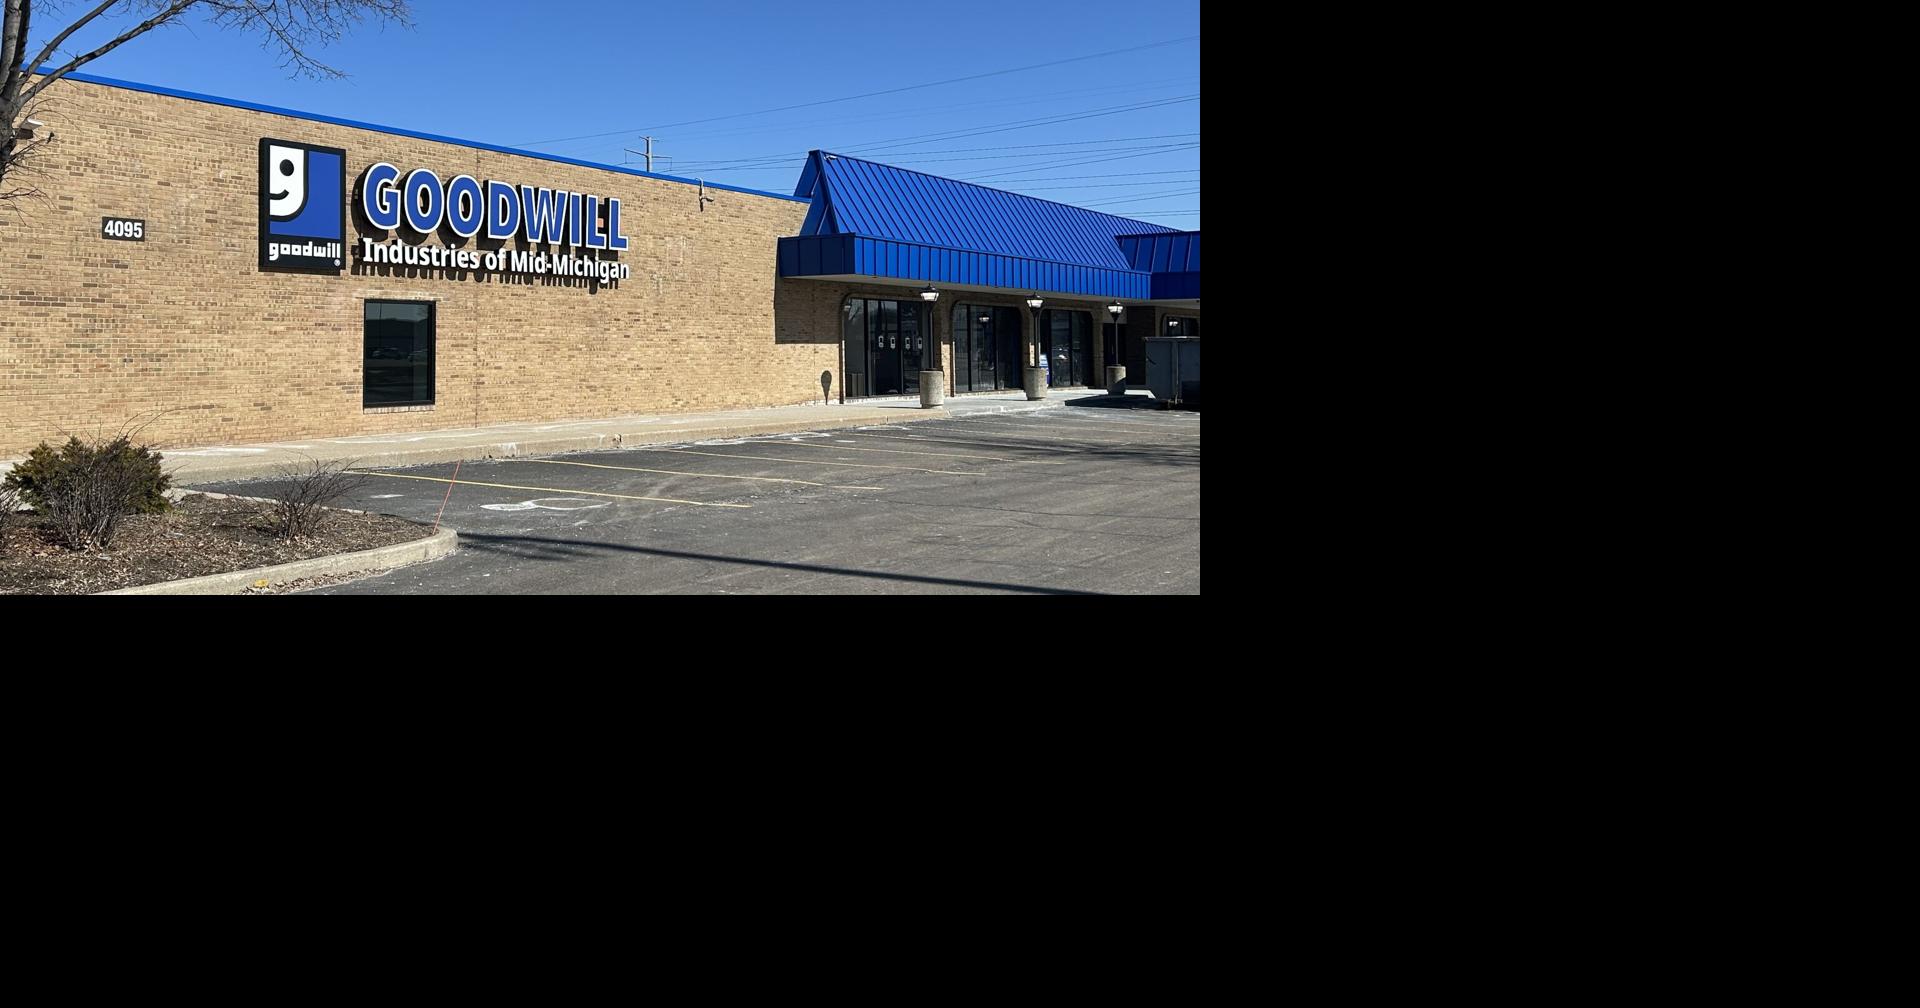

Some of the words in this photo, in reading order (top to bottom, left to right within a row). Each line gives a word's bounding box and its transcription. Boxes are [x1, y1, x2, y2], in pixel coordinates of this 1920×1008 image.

[362, 162, 629, 251] GOODWILL
[104, 220, 143, 239] 4095
[268, 241, 341, 261] goodwill
[363, 237, 480, 269] Industries
[485, 249, 506, 271] of
[511, 250, 630, 283] Mid-Michigan
